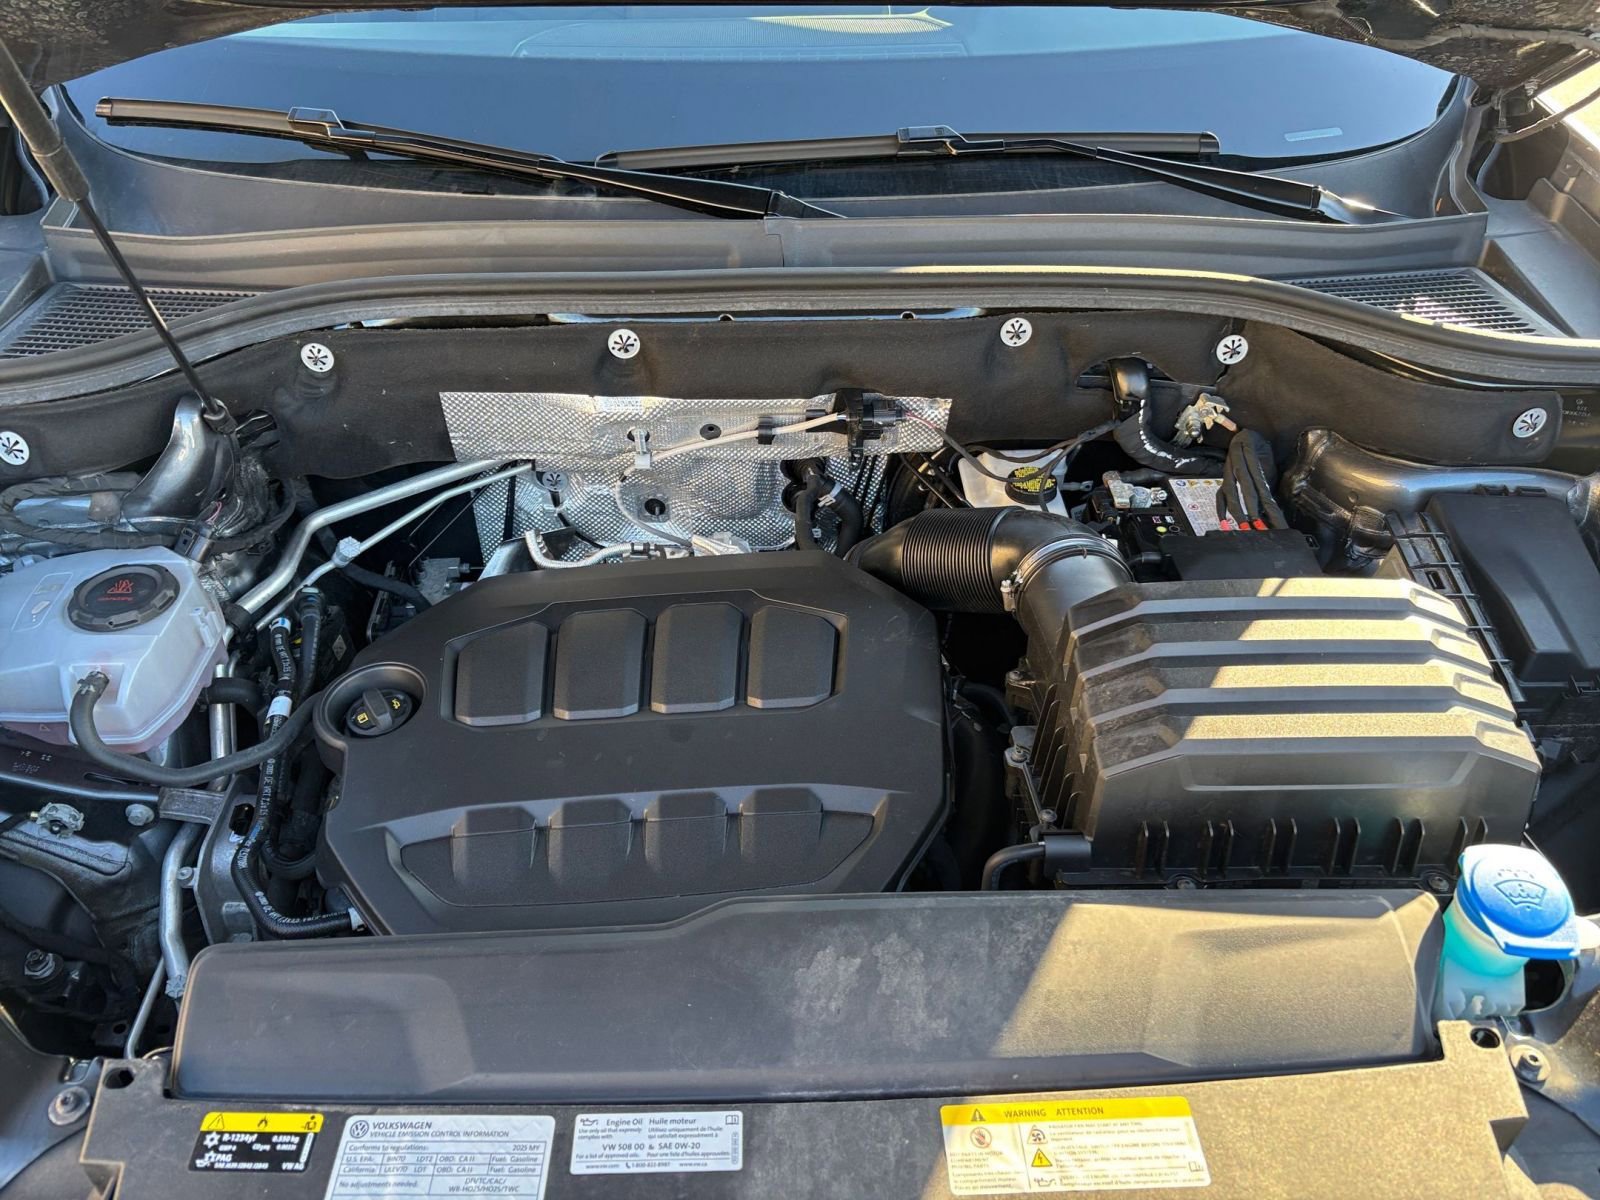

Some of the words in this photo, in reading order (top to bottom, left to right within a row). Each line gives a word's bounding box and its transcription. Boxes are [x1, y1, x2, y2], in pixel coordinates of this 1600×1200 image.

[1004, 1109, 1046, 1118] WARNING
[1056, 1107, 1104, 1116] ATTENTION
[372, 1121, 432, 1130] VOLKSWAGEN
[606, 1119, 631, 1127] Engine
[222, 1133, 258, 1144] R-1234yf
[290, 1134, 300, 1144] kg
[216, 1154, 232, 1162] PAG
[282, 1162, 294, 1170] VW
[294, 1162, 305, 1170] AG
